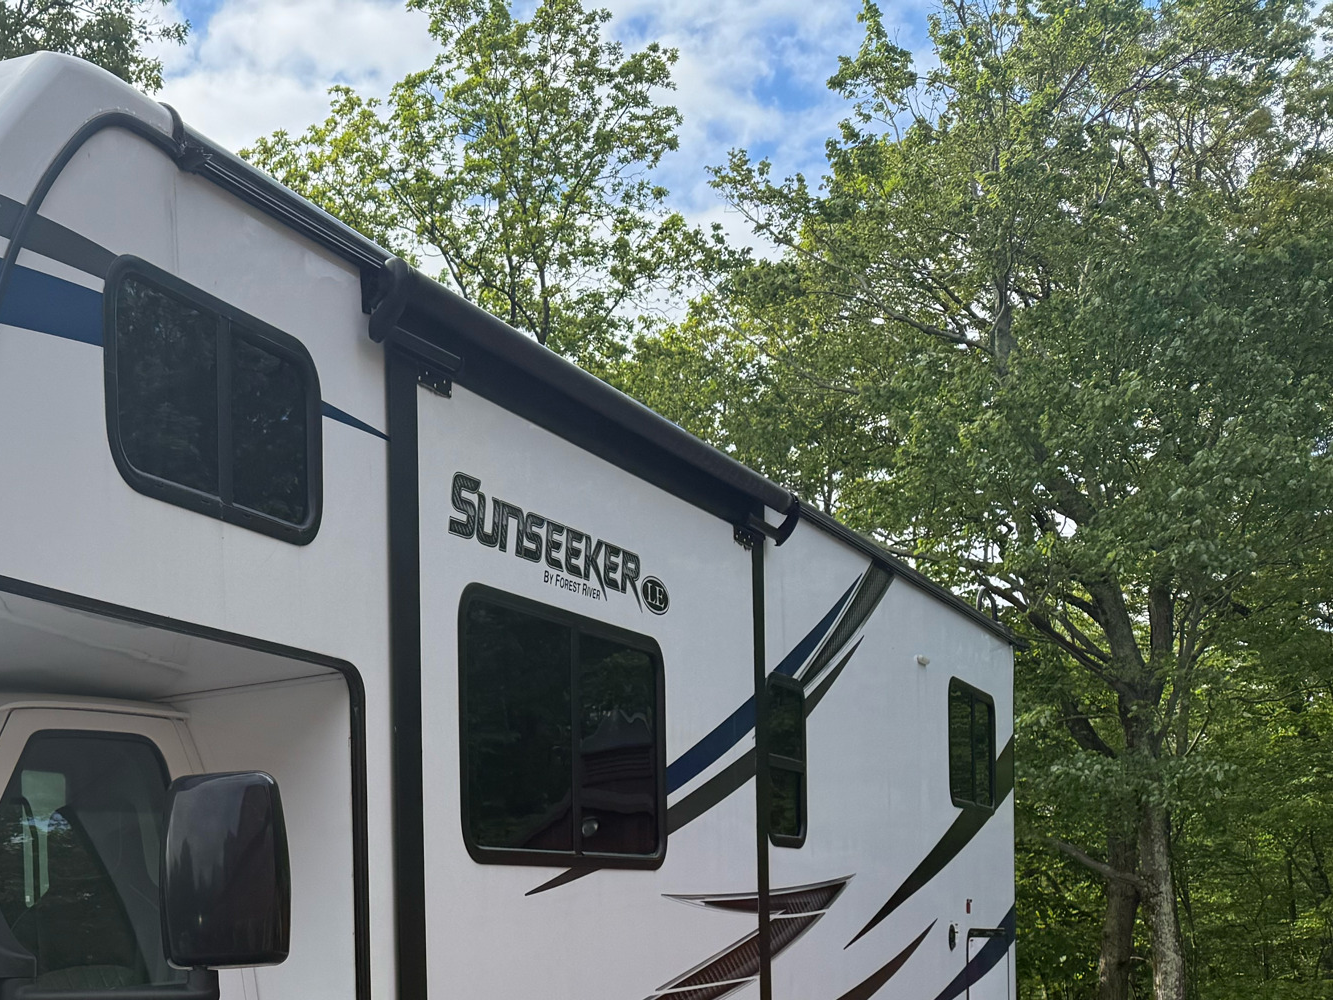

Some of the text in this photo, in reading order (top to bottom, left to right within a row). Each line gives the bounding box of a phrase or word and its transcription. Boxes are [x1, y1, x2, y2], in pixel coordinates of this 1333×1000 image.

[448, 471, 644, 614] SUNSEEKER
[581, 583, 601, 601] RIVER
[646, 582, 665, 609] LE
